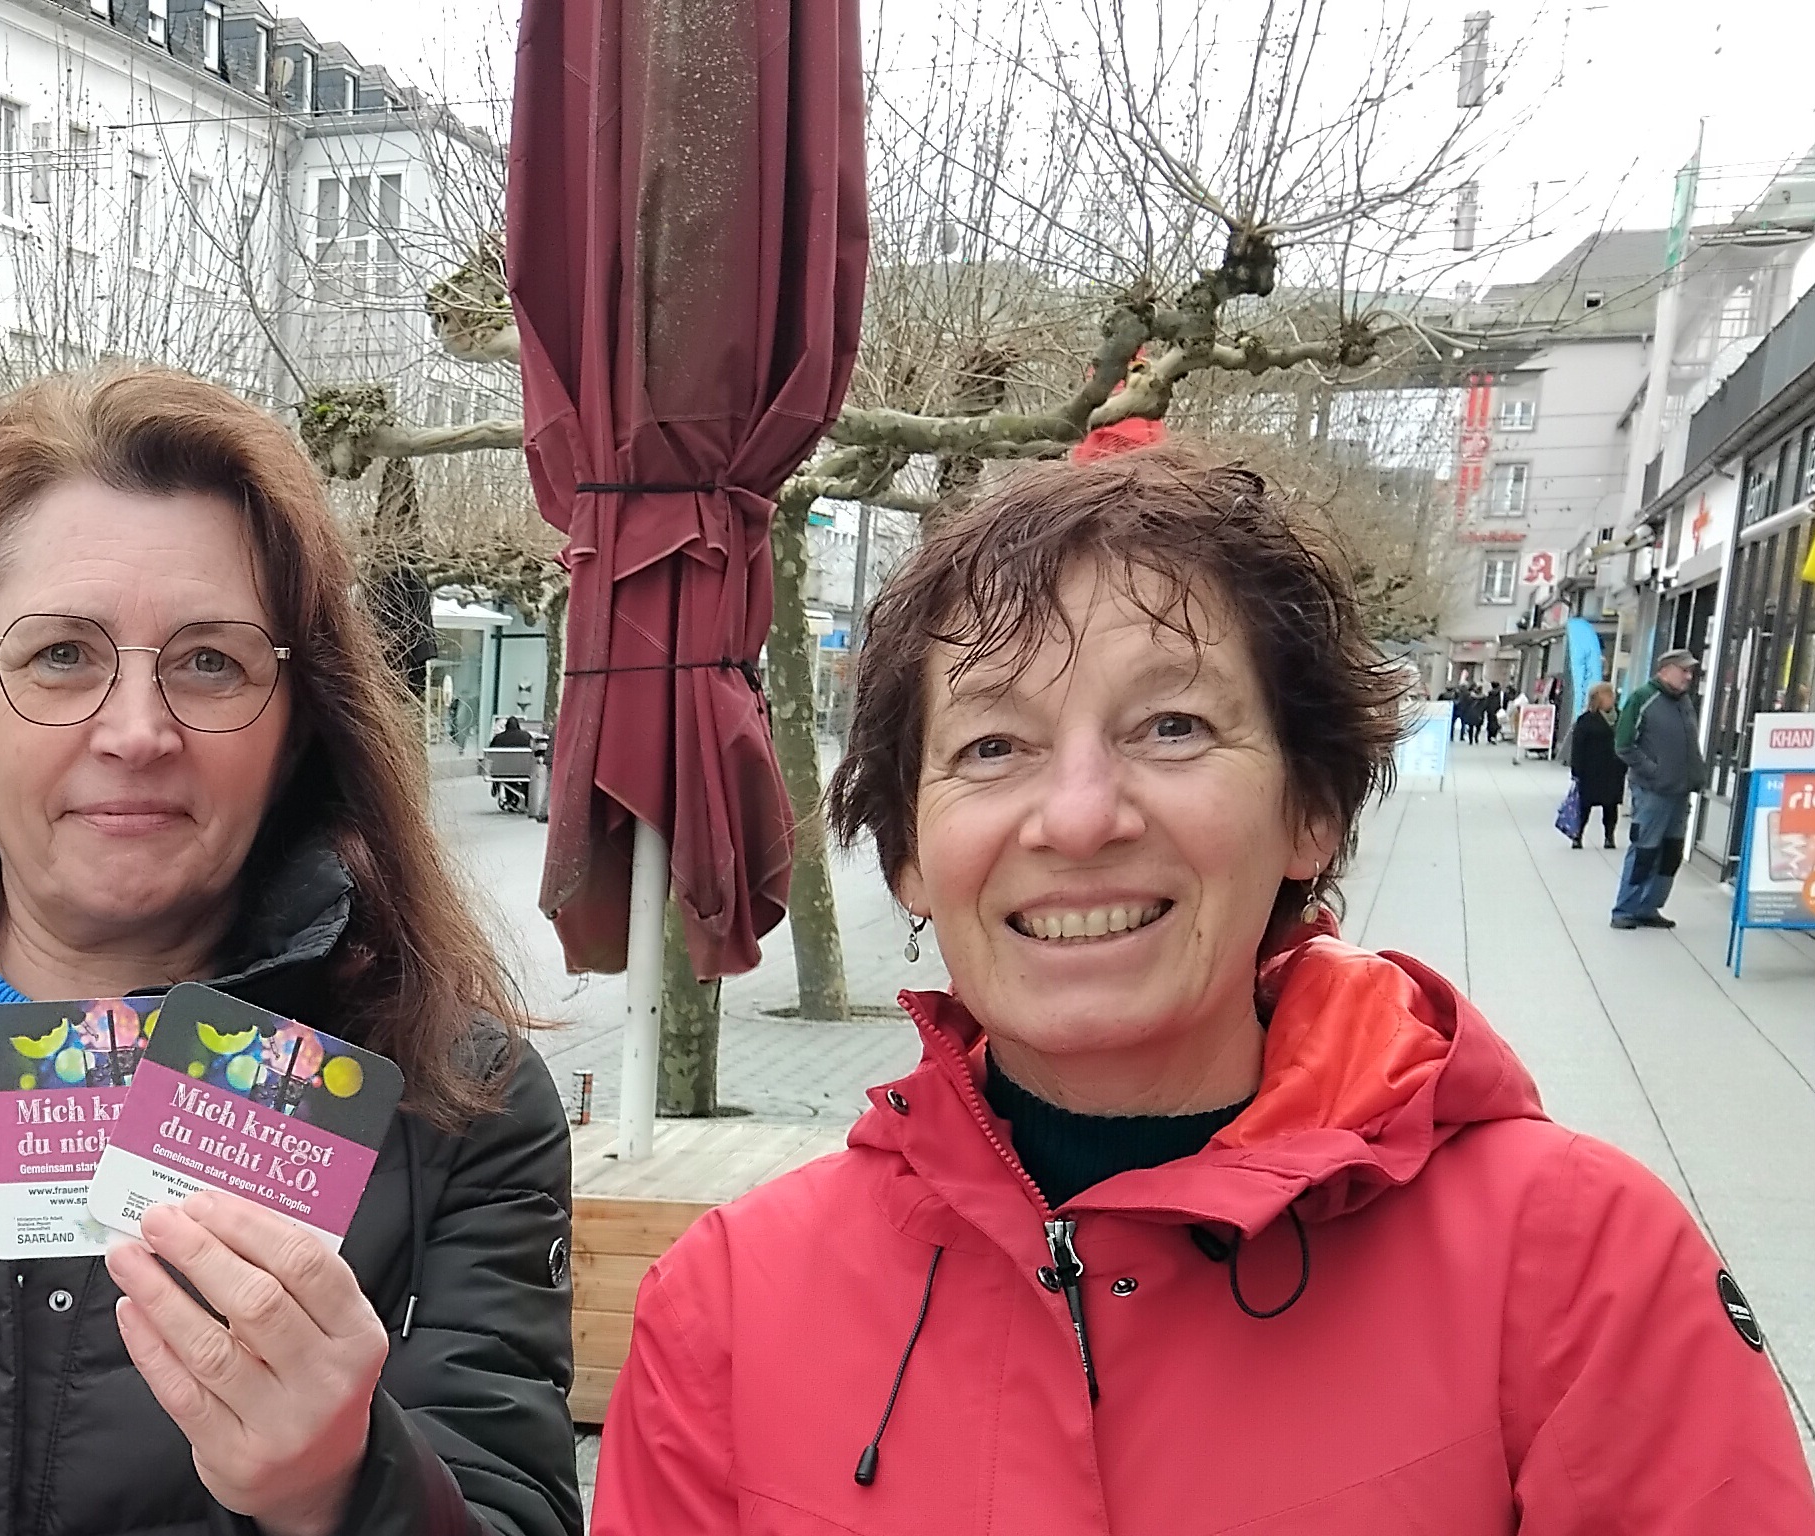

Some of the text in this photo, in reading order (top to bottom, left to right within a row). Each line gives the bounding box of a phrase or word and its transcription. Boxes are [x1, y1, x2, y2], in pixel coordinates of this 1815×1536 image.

[16, 1096, 123, 1124] Mich kr
[169, 1081, 335, 1167] Mich kriegst
[18, 1128, 111, 1156] du nich
[20, 1163, 74, 1174] Gemeinsam
[152, 1143, 204, 1172] Gemeinsam
[204, 1164, 228, 1181] stark
[228, 1175, 257, 1192] gegen
[159, 1116, 320, 1197] du nicht K.O.
[50, 1197, 87, 1205] www.sp
[17, 1232, 74, 1244] SAARLAND
